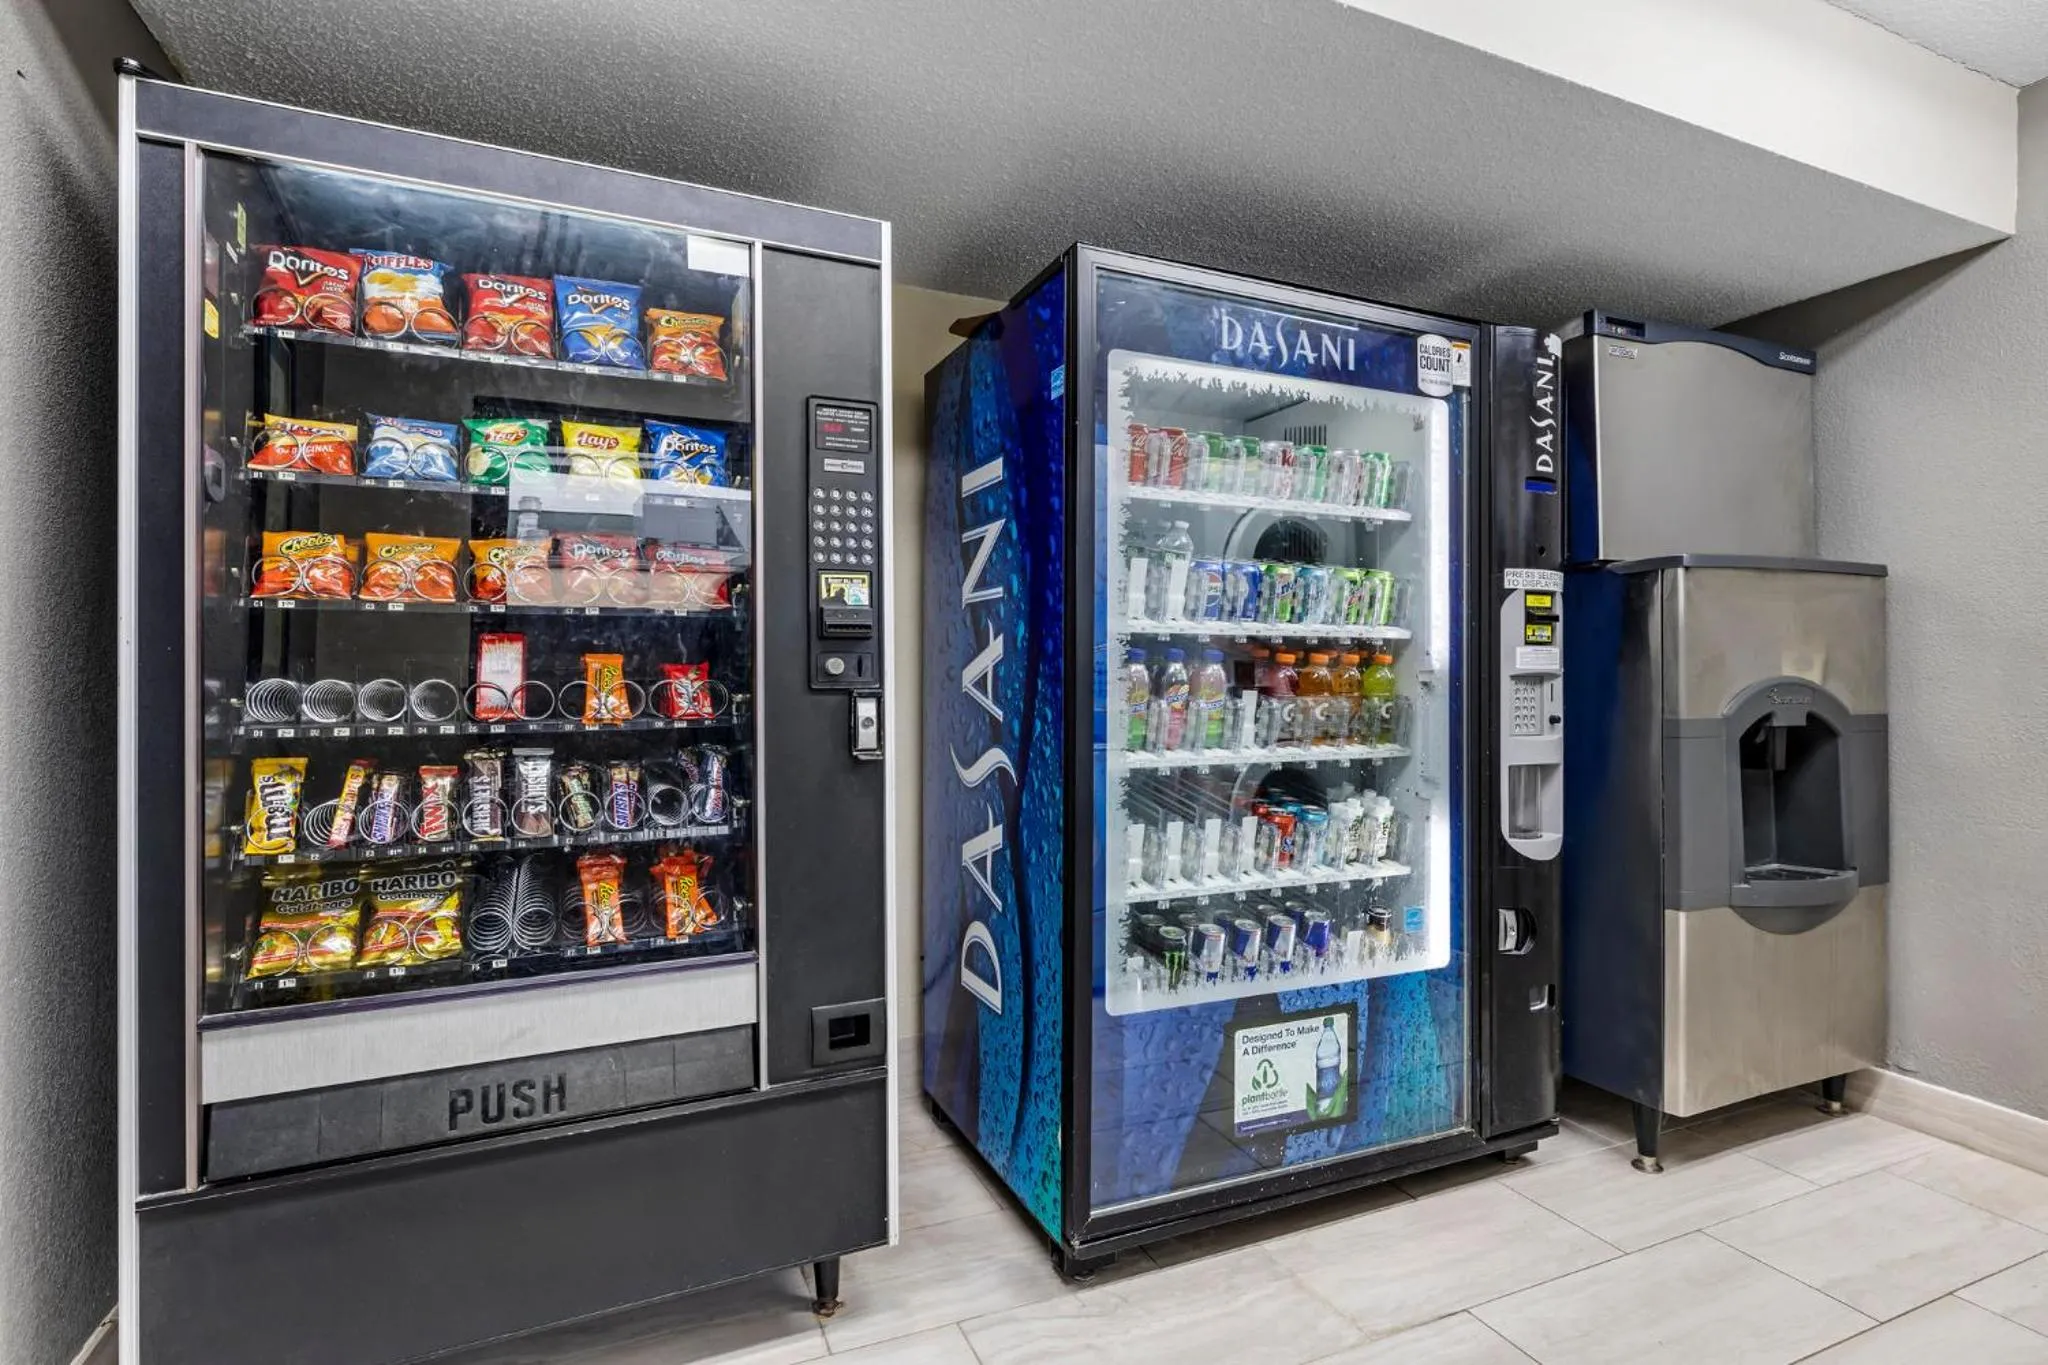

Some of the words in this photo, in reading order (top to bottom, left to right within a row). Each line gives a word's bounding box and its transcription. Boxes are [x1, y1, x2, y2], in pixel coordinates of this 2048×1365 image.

[268, 250, 349, 281] Doritos
[364, 253, 433, 271] RUFFLES
[478, 278, 547, 302] Doritos
[567, 292, 631, 311] Doritos
[1221, 308, 1355, 371] DASANI
[1420, 343, 1451, 359] CALORIES
[1420, 355, 1450, 372] COUNT
[1530, 356, 1557, 473] DASANI
[578, 431, 619, 448] Lay's
[663, 438, 717, 455] Doritos
[281, 533, 336, 554] Cheetos
[574, 544, 630, 559] Doritos
[655, 550, 706, 565] Doritos
[1507, 579, 1520, 587] TO
[949, 456, 1018, 1015] DASANI
[527, 760, 548, 815] RSHEY'S
[471, 776, 492, 835] HERSHEY'S
[273, 878, 360, 902] HARIBO
[371, 870, 456, 892] HARIBO
[599, 881, 617, 910] Rees
[276, 898, 354, 915] Goldbears
[1242, 1031, 1283, 1045] Designed
[1285, 1027, 1295, 1037] To
[1296, 1025, 1320, 1035] Make
[1242, 1047, 1250, 1056] A
[1251, 1041, 1297, 1055] Difference
[448, 1071, 568, 1132] PUSH
